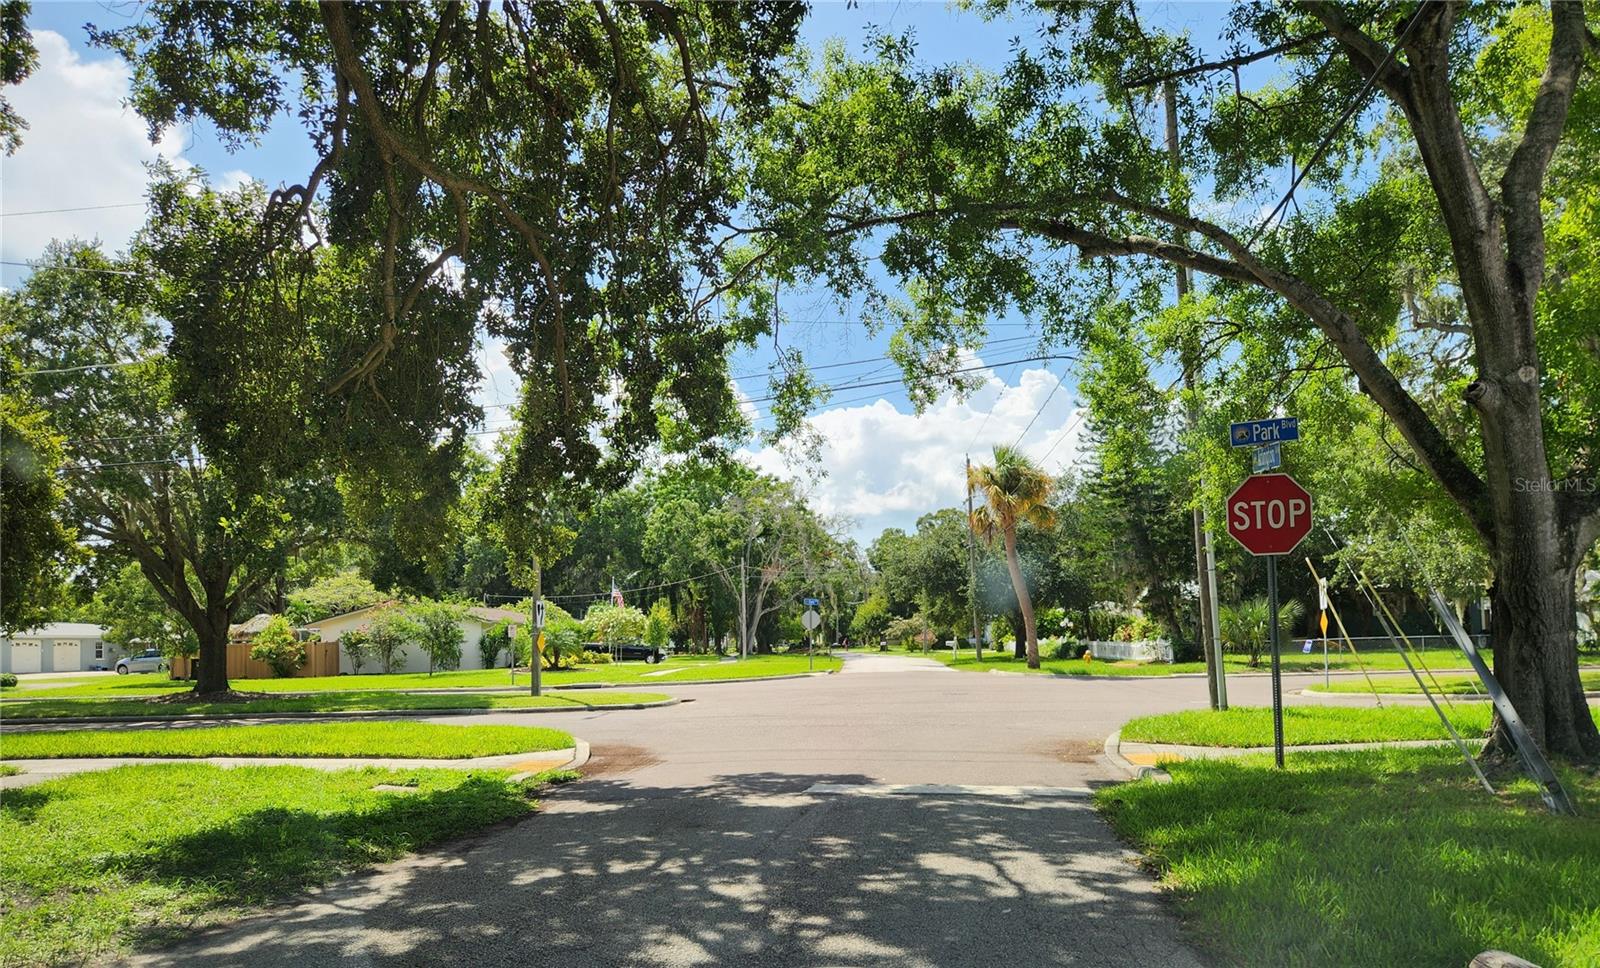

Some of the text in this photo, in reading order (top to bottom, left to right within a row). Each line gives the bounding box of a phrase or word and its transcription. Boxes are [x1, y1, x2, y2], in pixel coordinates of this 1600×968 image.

[1252, 419, 1296, 441] Park Blvd
[1233, 499, 1306, 531] STOP
